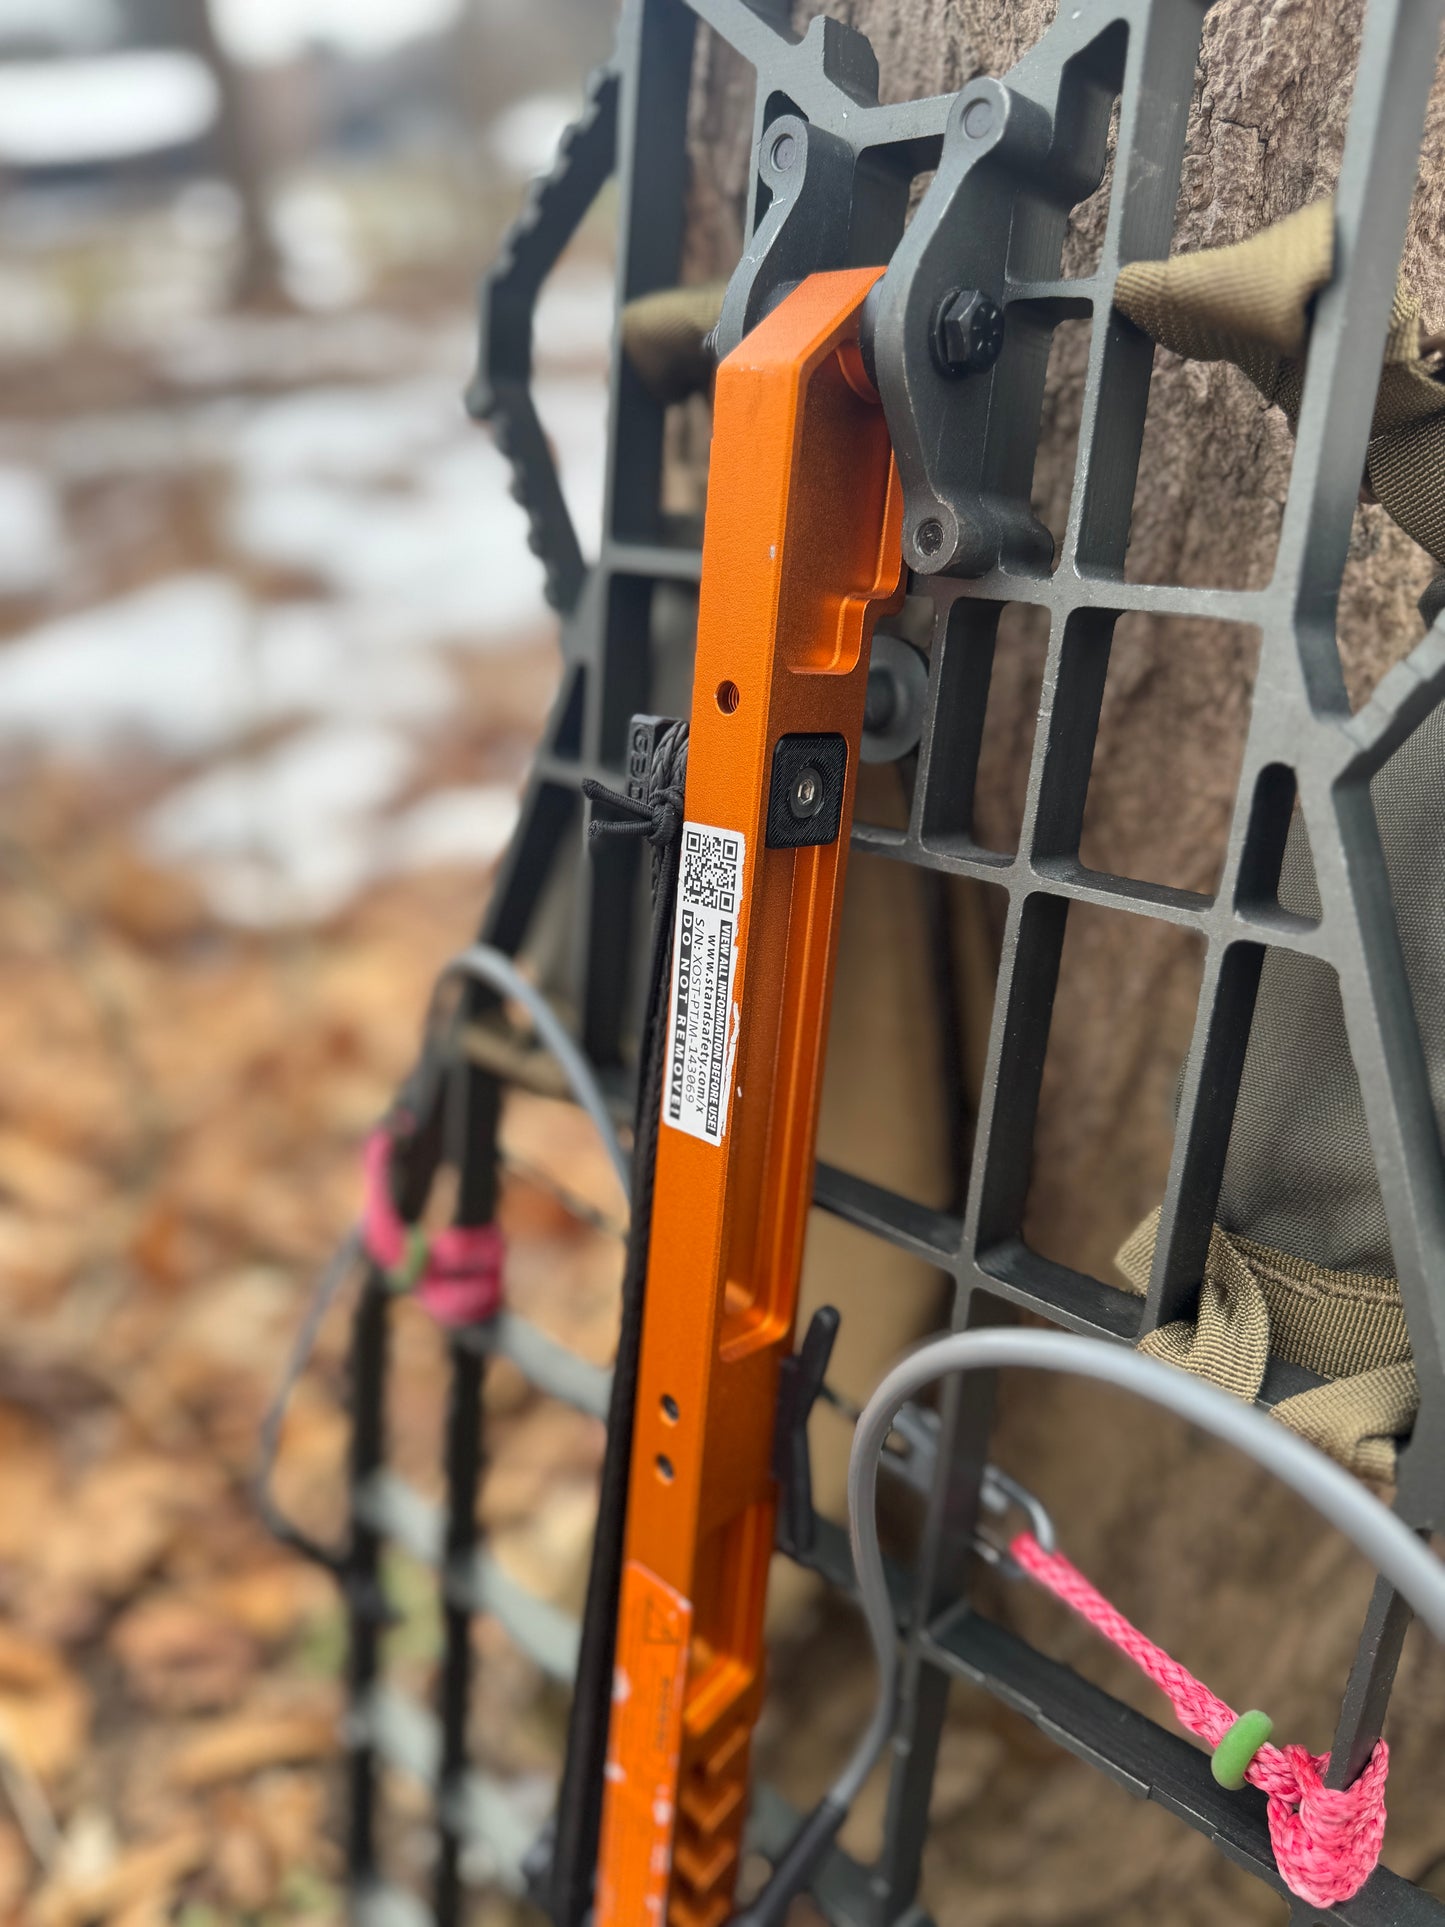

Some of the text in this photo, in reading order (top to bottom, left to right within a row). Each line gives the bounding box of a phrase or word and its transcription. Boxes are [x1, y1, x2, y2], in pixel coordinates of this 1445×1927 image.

[670, 914, 693, 1116] DO NOT REMOVE!
[685, 917, 705, 1103] S/N: XOST-PTJM-143069
[695, 935, 716, 1114] www.standsafety.com/x
[707, 925, 731, 1132] VIEW ALL INFORMATION BEFORE USE!
